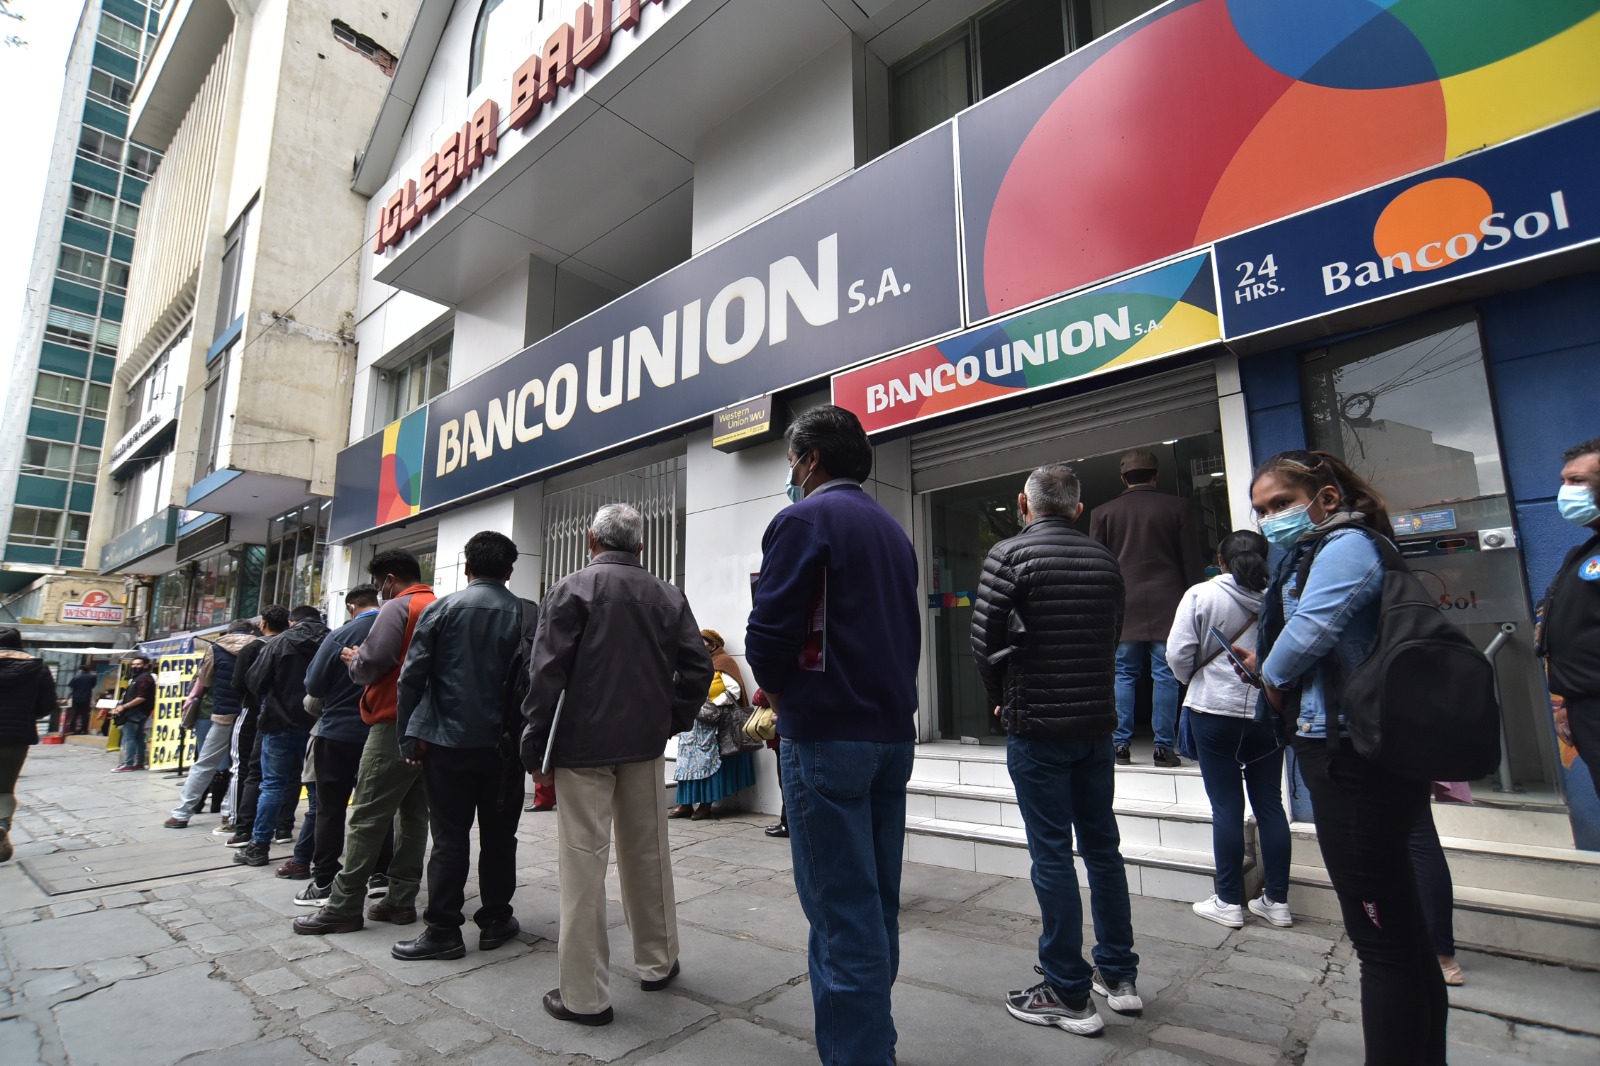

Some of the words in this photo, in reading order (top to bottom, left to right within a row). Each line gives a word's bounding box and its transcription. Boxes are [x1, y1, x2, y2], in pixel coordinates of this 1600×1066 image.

[373, 98, 498, 255] IGLESIA
[1321, 190, 1570, 296] BancoSol
[1235, 254, 1278, 288] 24
[1234, 279, 1285, 305] HRS.
[436, 363, 578, 478] BANCO
[587, 233, 838, 413] UNION
[848, 267, 911, 314] S.A.
[867, 355, 980, 414] BANCO
[986, 305, 1131, 378] UNION
[1134, 319, 1163, 336] S.A.
[719, 407, 749, 423] Western
[728, 417, 748, 429] Union
[1439, 591, 1477, 610] Sol
[158, 702, 172, 719] DE
[156, 725, 168, 742] 30
[152, 746, 165, 764] 50
